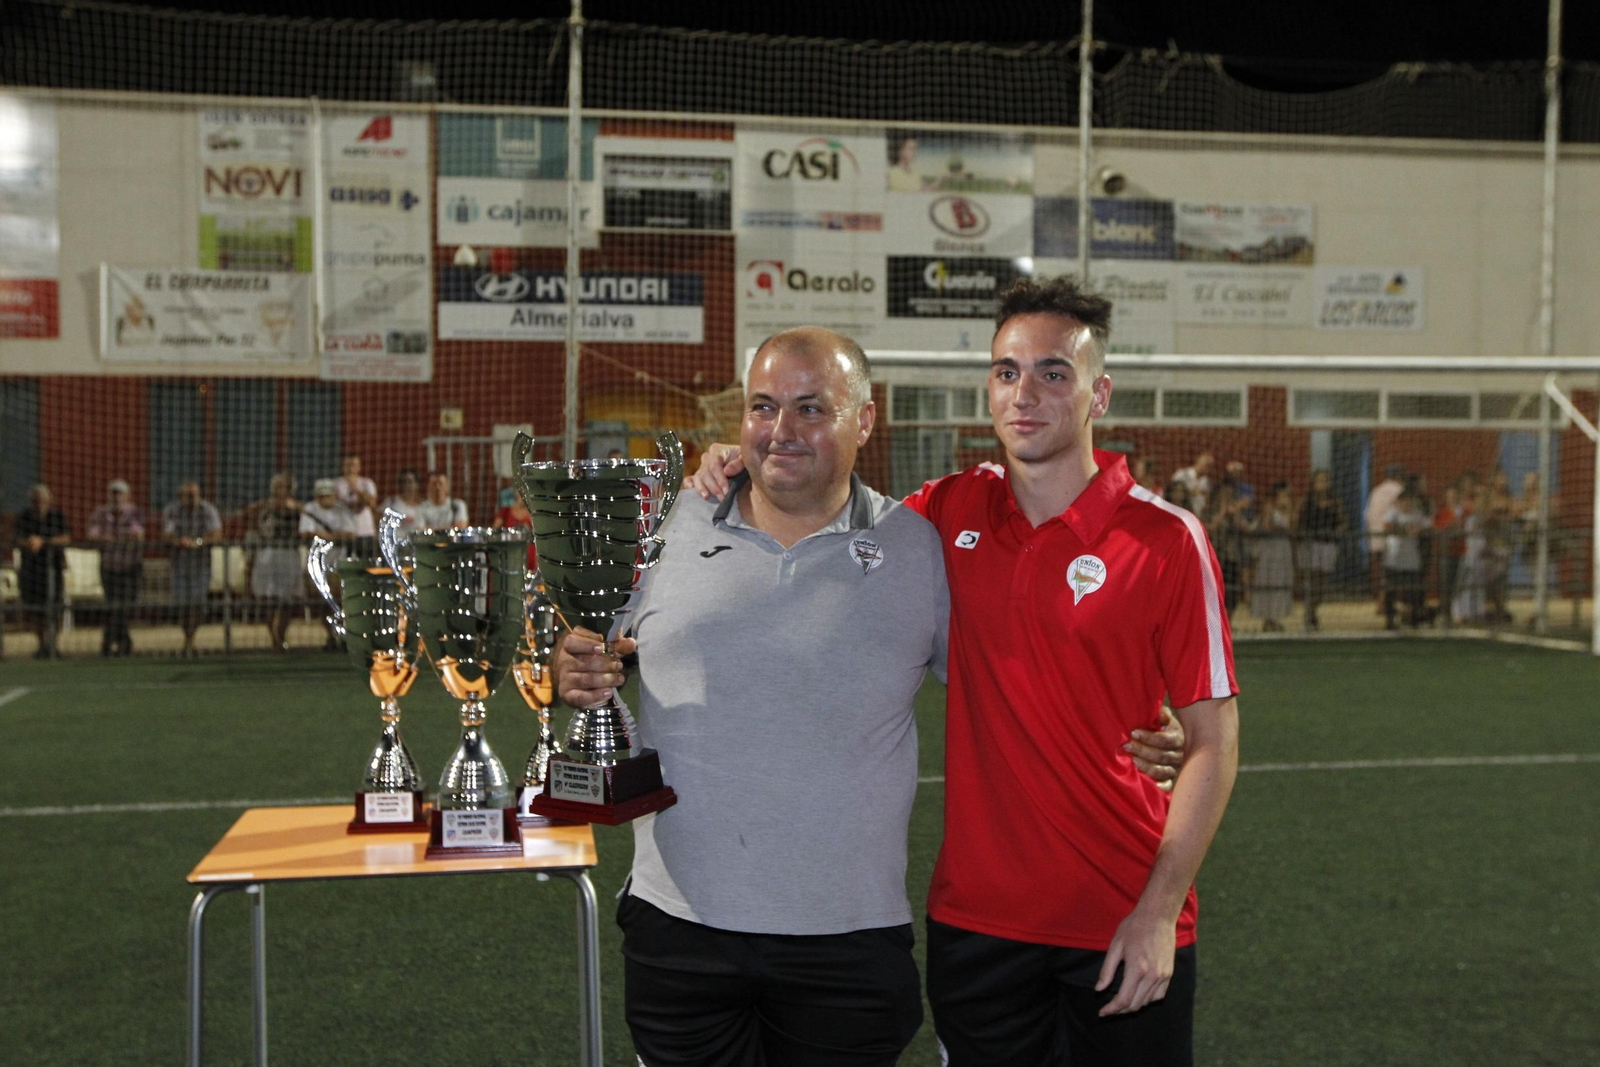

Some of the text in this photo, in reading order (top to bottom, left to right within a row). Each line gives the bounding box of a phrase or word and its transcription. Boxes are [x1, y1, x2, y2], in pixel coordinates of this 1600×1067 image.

[763, 149, 839, 180] CASI
[205, 166, 303, 197] NOVI
[487, 197, 590, 226] cajamr
[535, 276, 670, 302] HYUNDAI
[510, 308, 635, 329] Almeialva
